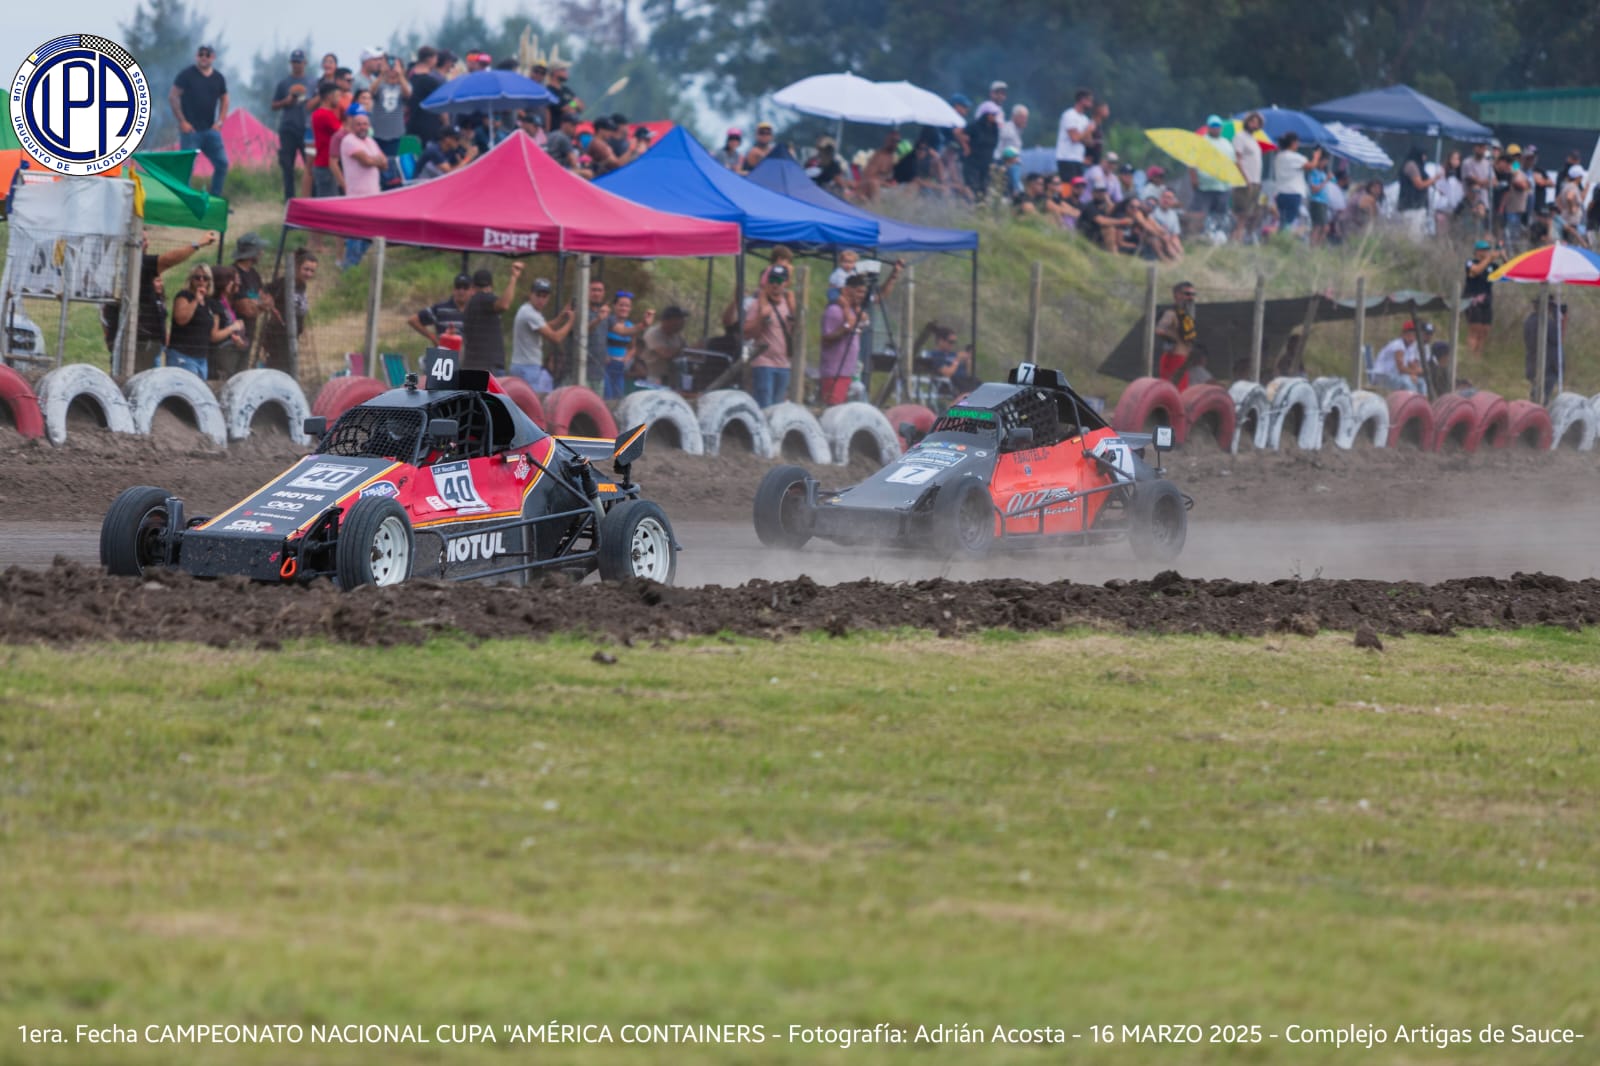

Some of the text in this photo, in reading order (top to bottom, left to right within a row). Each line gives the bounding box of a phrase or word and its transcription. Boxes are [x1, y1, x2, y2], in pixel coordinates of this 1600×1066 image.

[483, 227, 540, 251] EXPERT
[431, 357, 454, 382] 40
[1023, 366, 1031, 379] 7
[303, 469, 354, 484] 40
[902, 468, 926, 479] 7
[272, 490, 326, 502] MOTUL
[443, 475, 477, 504] 40
